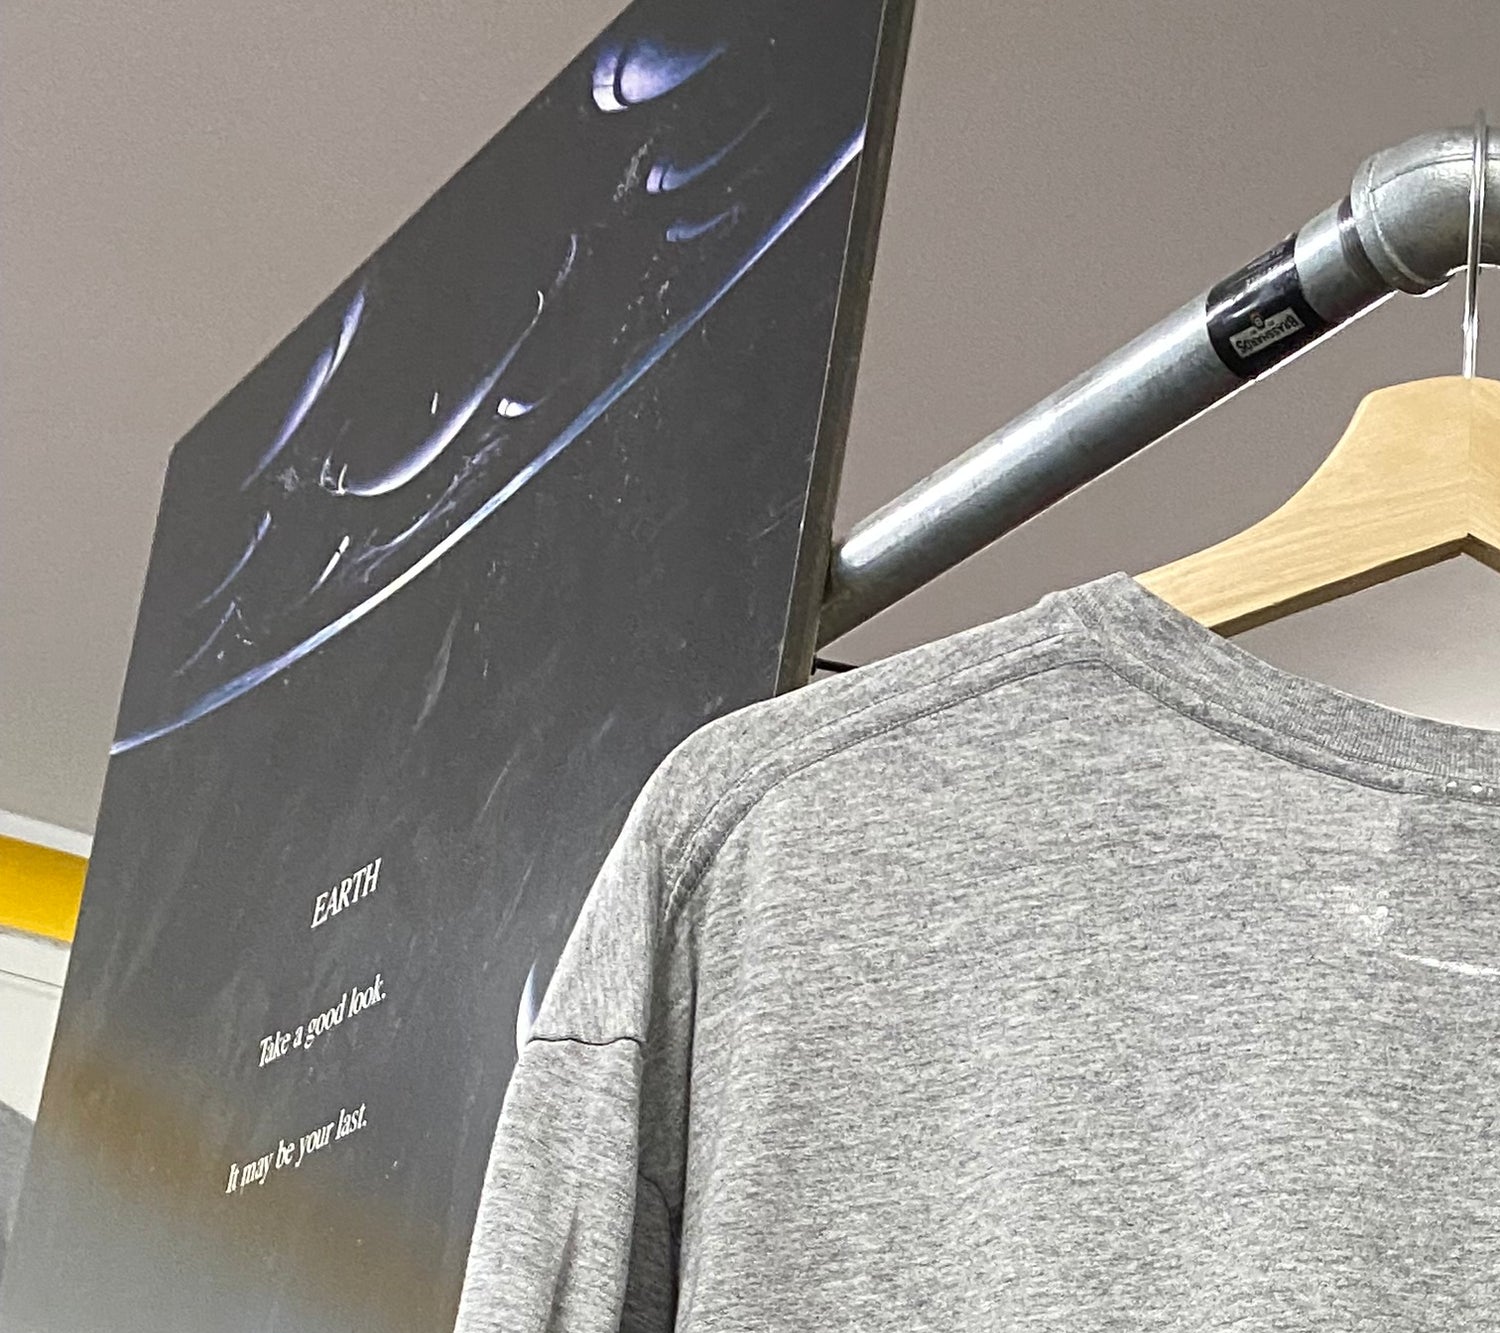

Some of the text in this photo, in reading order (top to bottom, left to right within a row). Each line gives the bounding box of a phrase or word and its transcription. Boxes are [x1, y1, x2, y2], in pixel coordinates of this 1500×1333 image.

[311, 857, 382, 929] EARTH
[259, 974, 386, 1067] Take a good look.
[225, 1103, 368, 1194] It may be your last.
